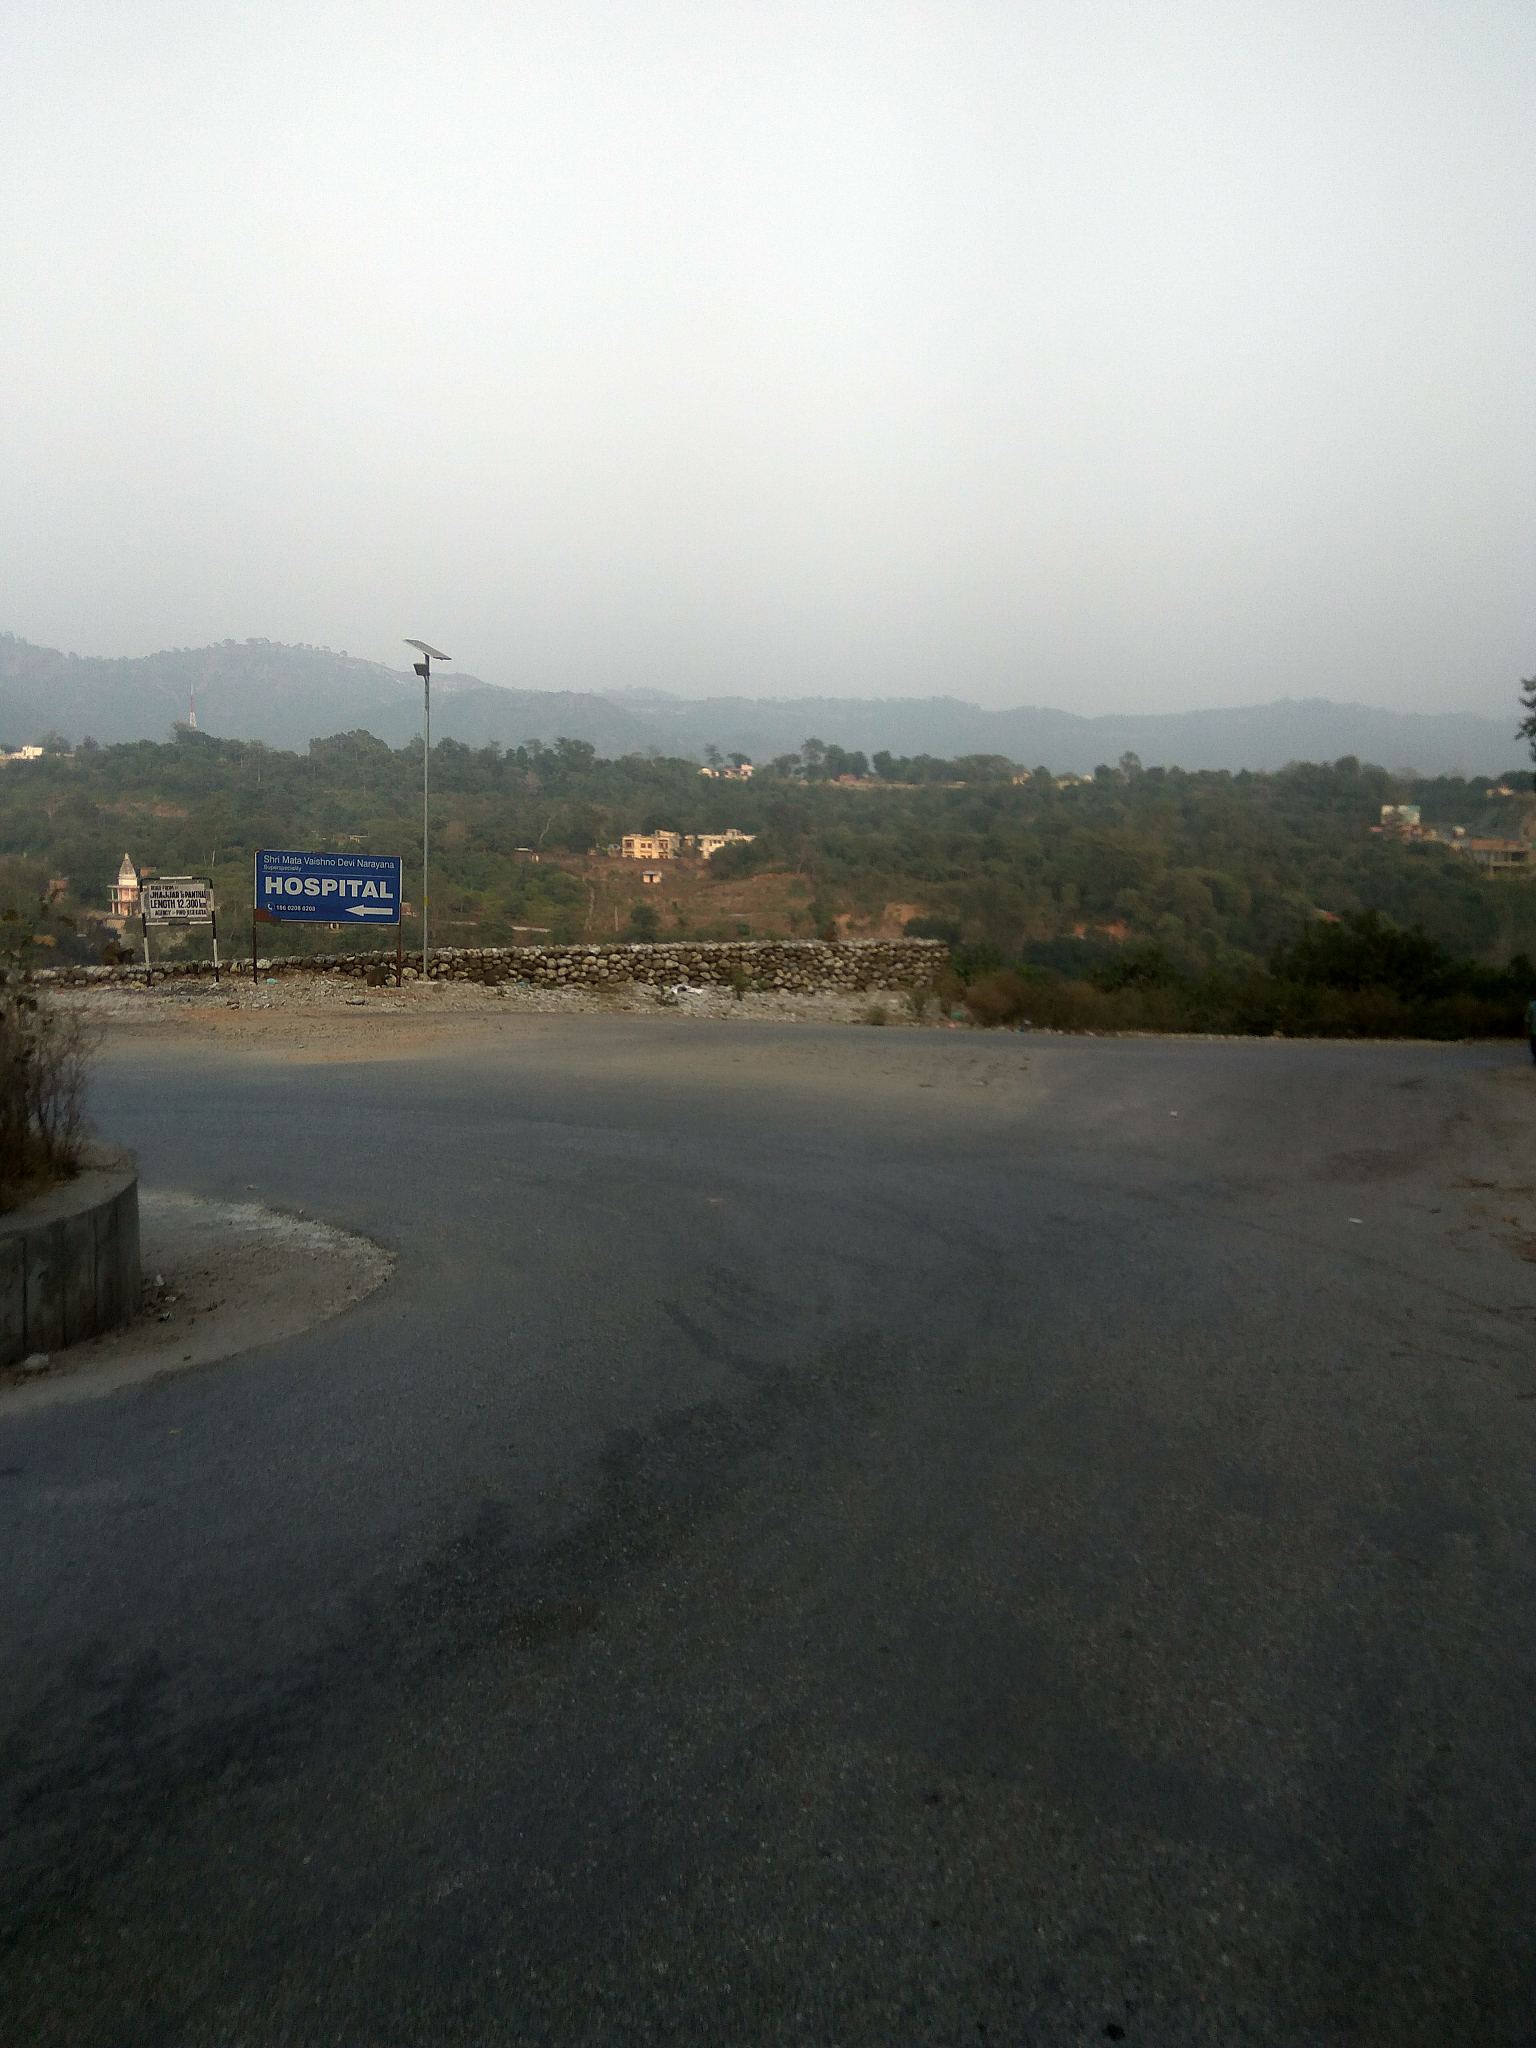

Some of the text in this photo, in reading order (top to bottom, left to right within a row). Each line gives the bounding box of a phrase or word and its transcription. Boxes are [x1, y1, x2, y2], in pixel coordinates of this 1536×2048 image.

[263, 855, 395, 869] Shri Mata Vaishno Devi Narayana
[265, 876, 394, 899] HOSPITAL
[150, 900, 176, 908] LENGTH
[177, 898, 198, 908] 12.300
